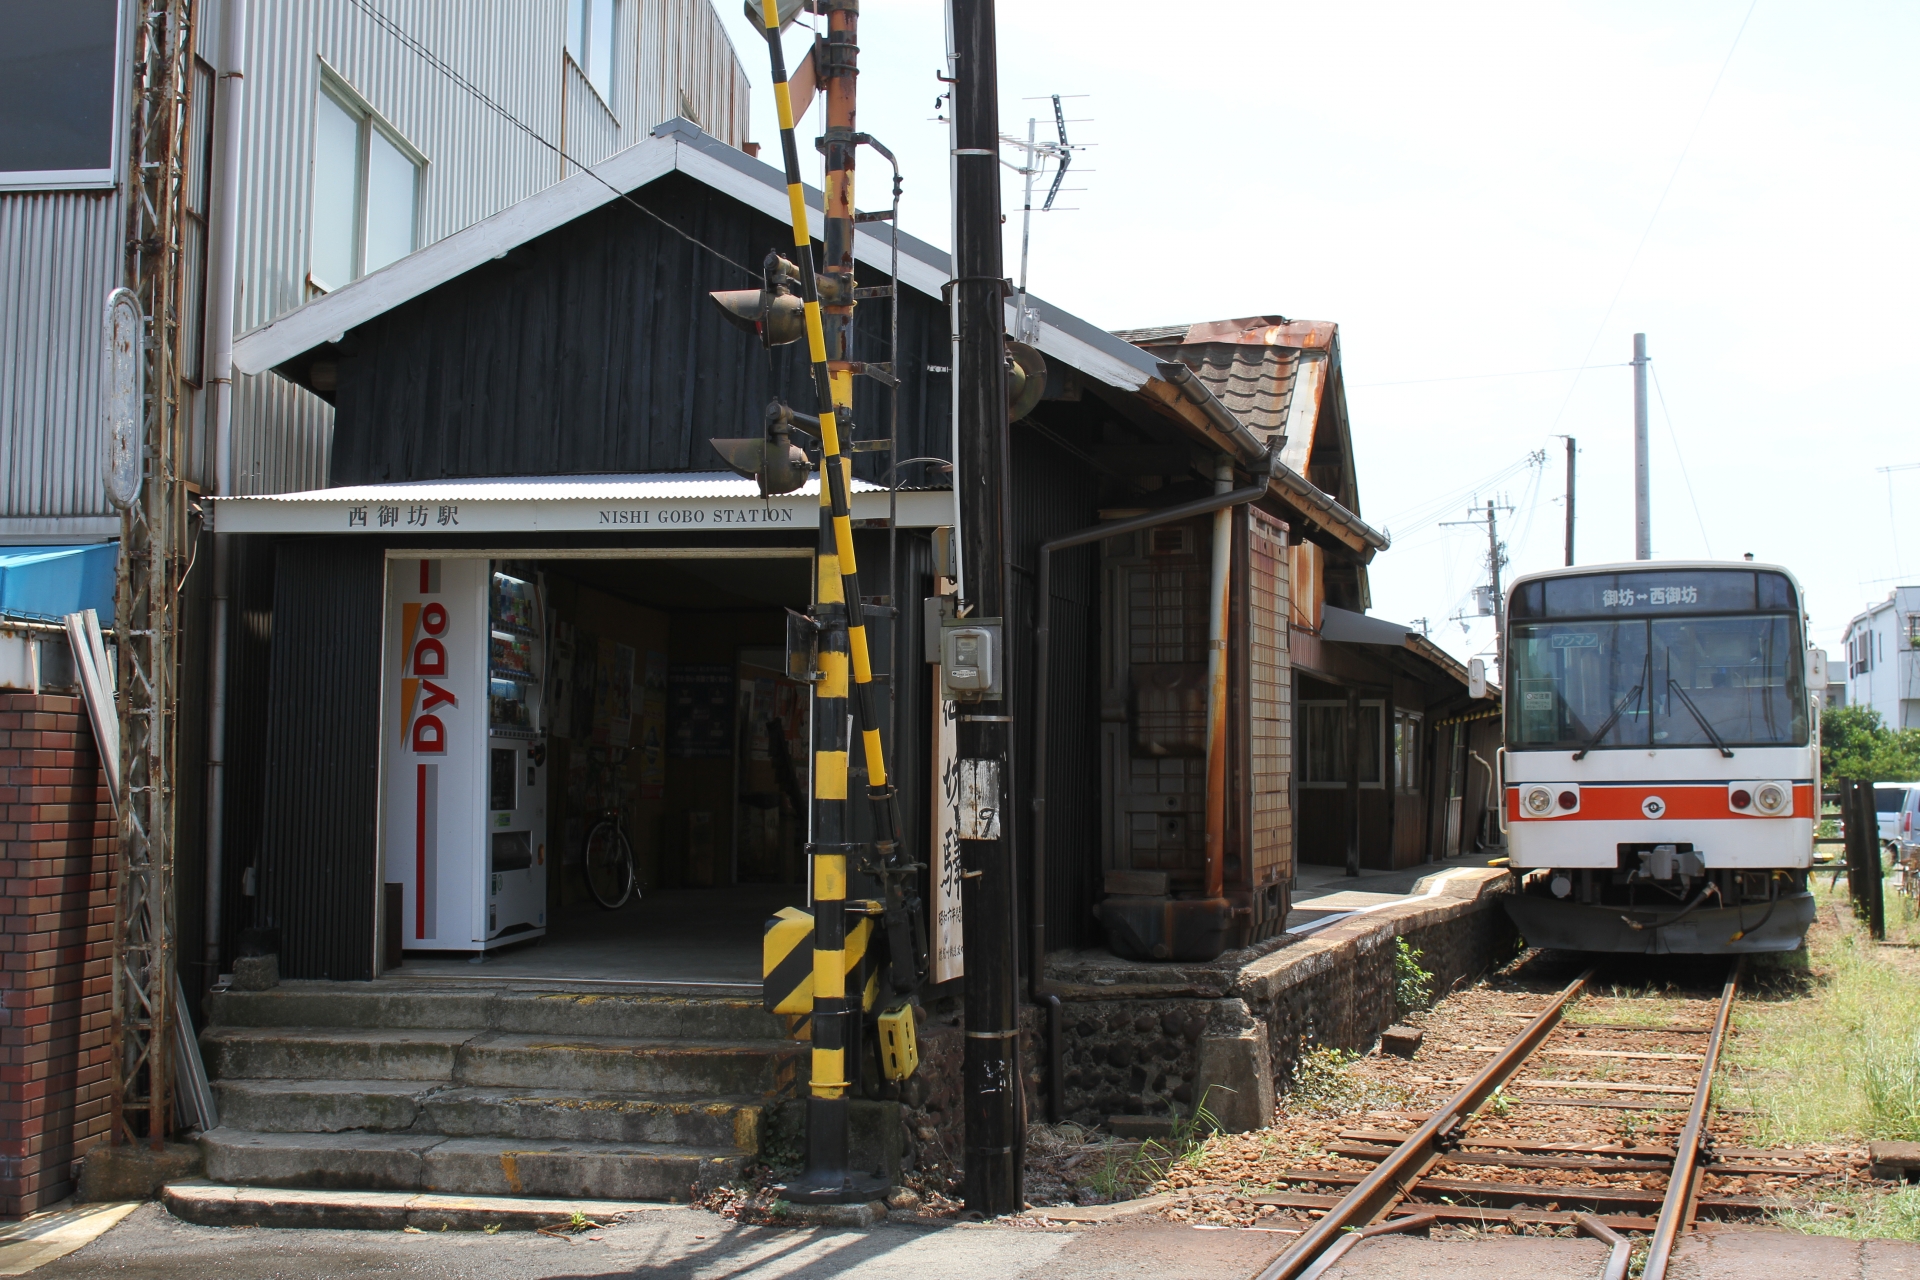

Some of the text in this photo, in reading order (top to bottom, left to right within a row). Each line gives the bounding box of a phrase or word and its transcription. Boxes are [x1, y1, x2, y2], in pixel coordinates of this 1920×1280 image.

[348, 504, 459, 528] 西御坊駅
[599, 508, 794, 524] NISHI GOBO STATION
[1602, 585, 1698, 607] 御坊 西御坊
[1553, 634, 1597, 646] ワンマン
[412, 602, 457, 754] DyDo
